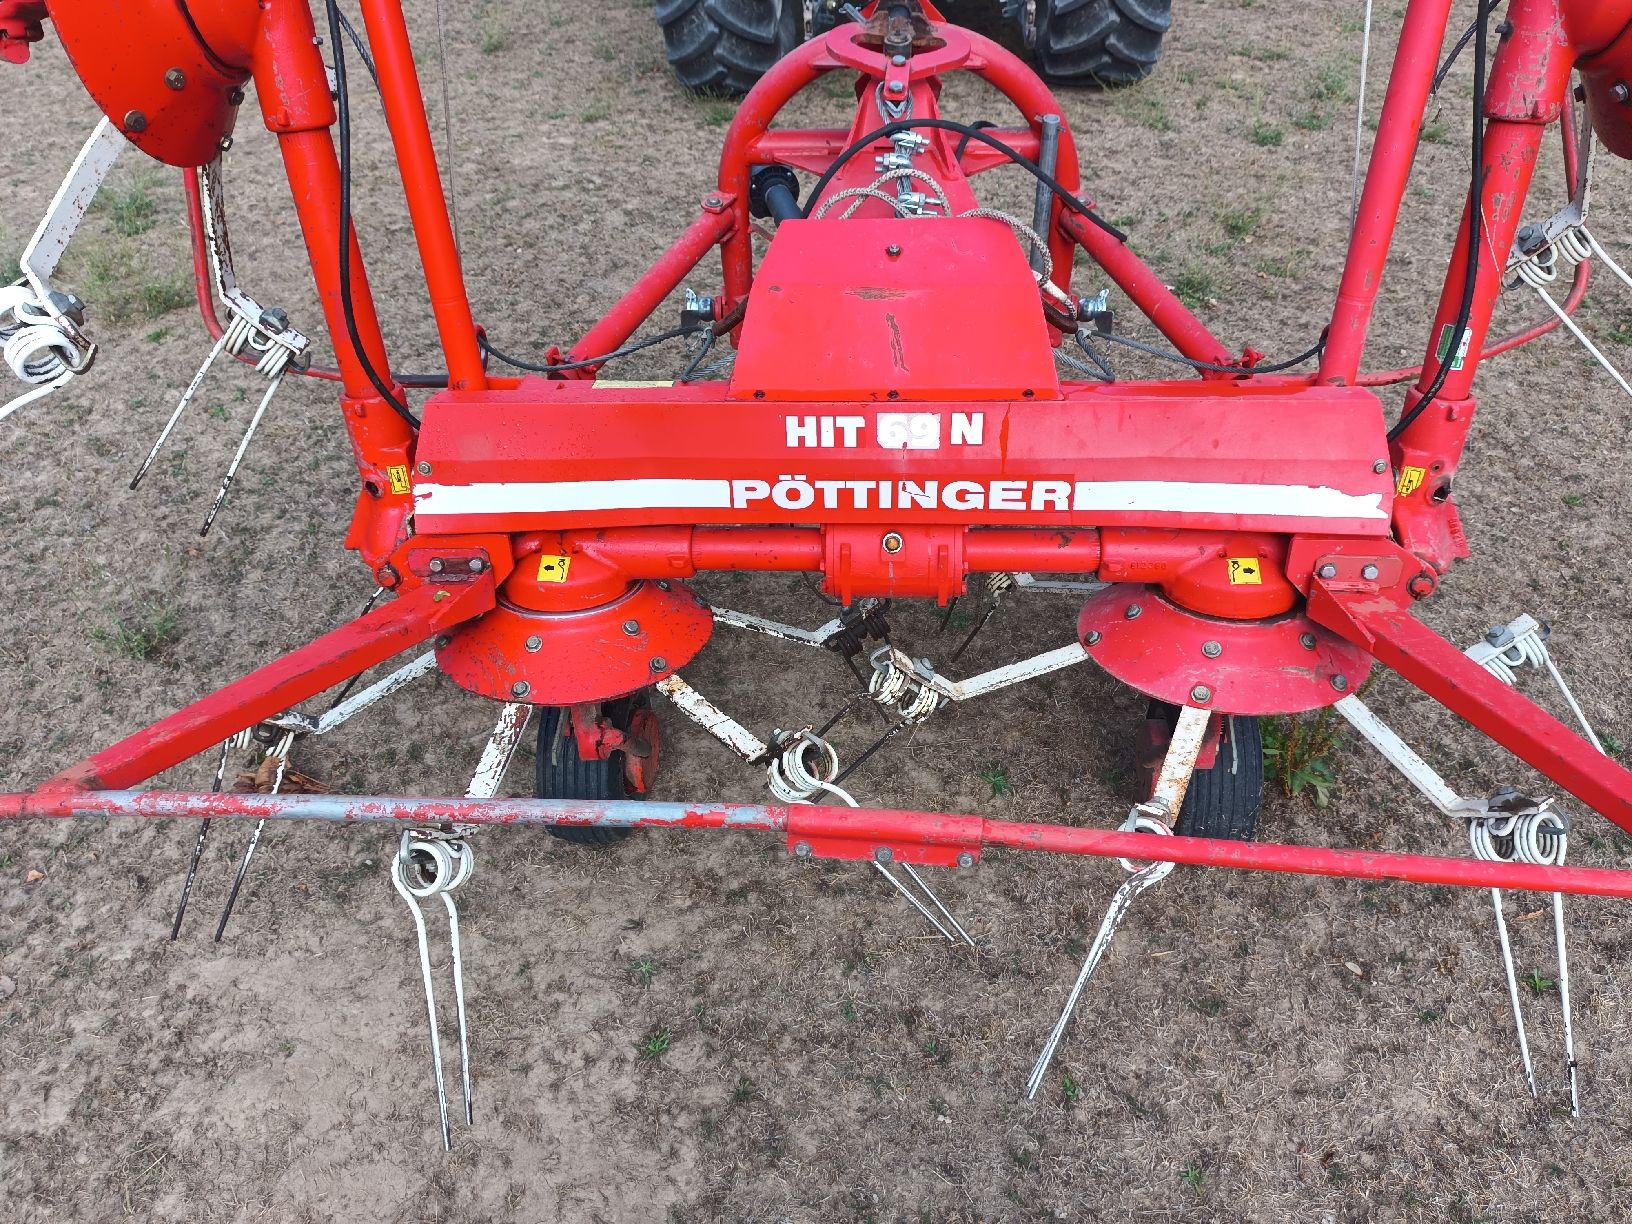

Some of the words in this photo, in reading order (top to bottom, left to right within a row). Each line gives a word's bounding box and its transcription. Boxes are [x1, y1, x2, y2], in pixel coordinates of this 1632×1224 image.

[785, 415, 865, 448] HIT
[876, 412, 941, 449] 69
[950, 412, 985, 446] N
[732, 474, 1072, 511] PÖTTINGER
